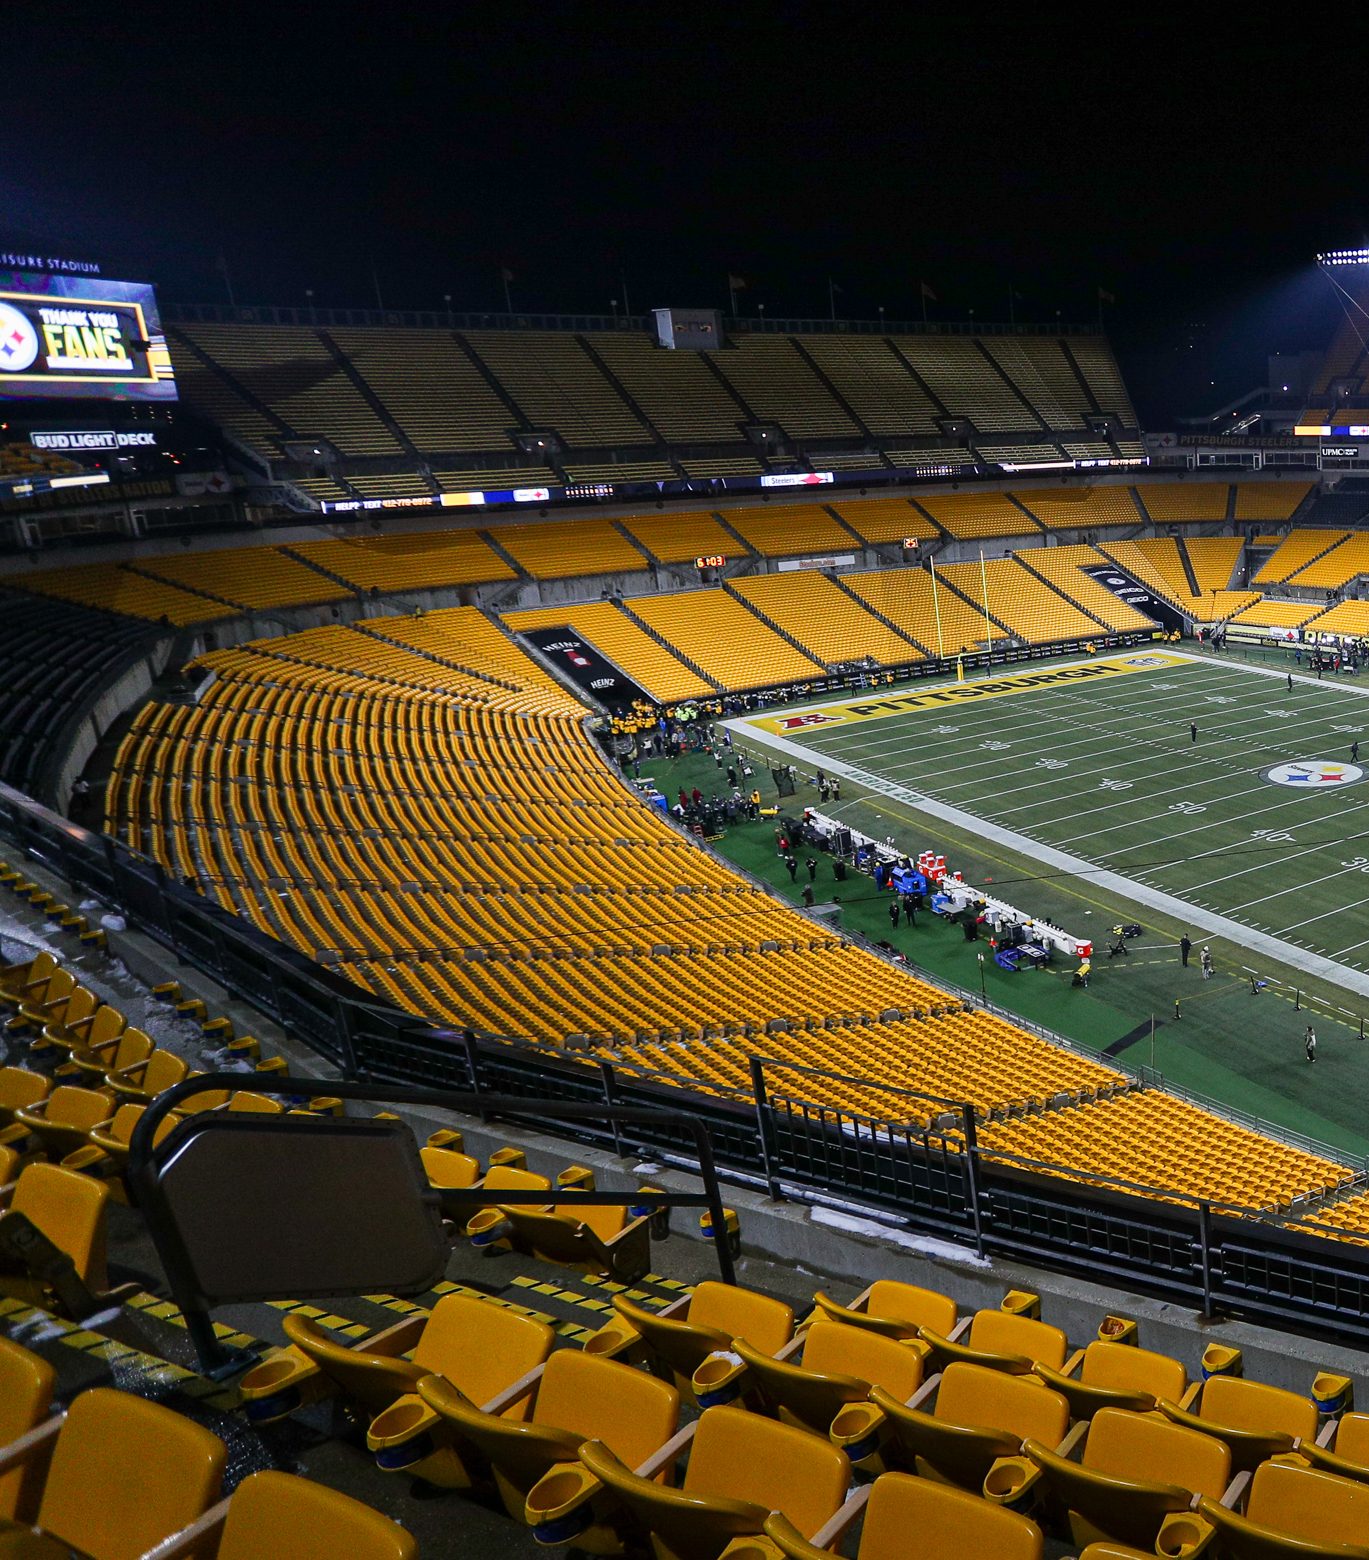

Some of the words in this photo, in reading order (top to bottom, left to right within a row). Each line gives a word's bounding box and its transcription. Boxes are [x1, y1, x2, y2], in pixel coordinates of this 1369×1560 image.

[0, 254, 43, 268] ISURE
[48, 259, 100, 273] STADIUM
[38, 307, 90, 326] THANK
[88, 312, 119, 328] YOU
[42, 324, 127, 360] FANS
[35, 434, 72, 448] BUD
[70, 433, 114, 447] LIGHT
[117, 433, 157, 446] DECK
[1180, 435, 1244, 447] PITTSBURGH
[1247, 437, 1299, 447] STEELERS
[1321, 448, 1345, 456] UPMC
[770, 476, 796, 485] Steelers
[905, 538, 917, 548] 25
[542, 641, 581, 652] HEINZ
[590, 678, 616, 689] HEINZ
[846, 665, 1122, 716] PITTSBURGH
[841, 770, 899, 793] AMERICA
[893, 791, 925, 804] 250
[1168, 801, 1207, 815] 50
[1250, 828, 1291, 842] 40
